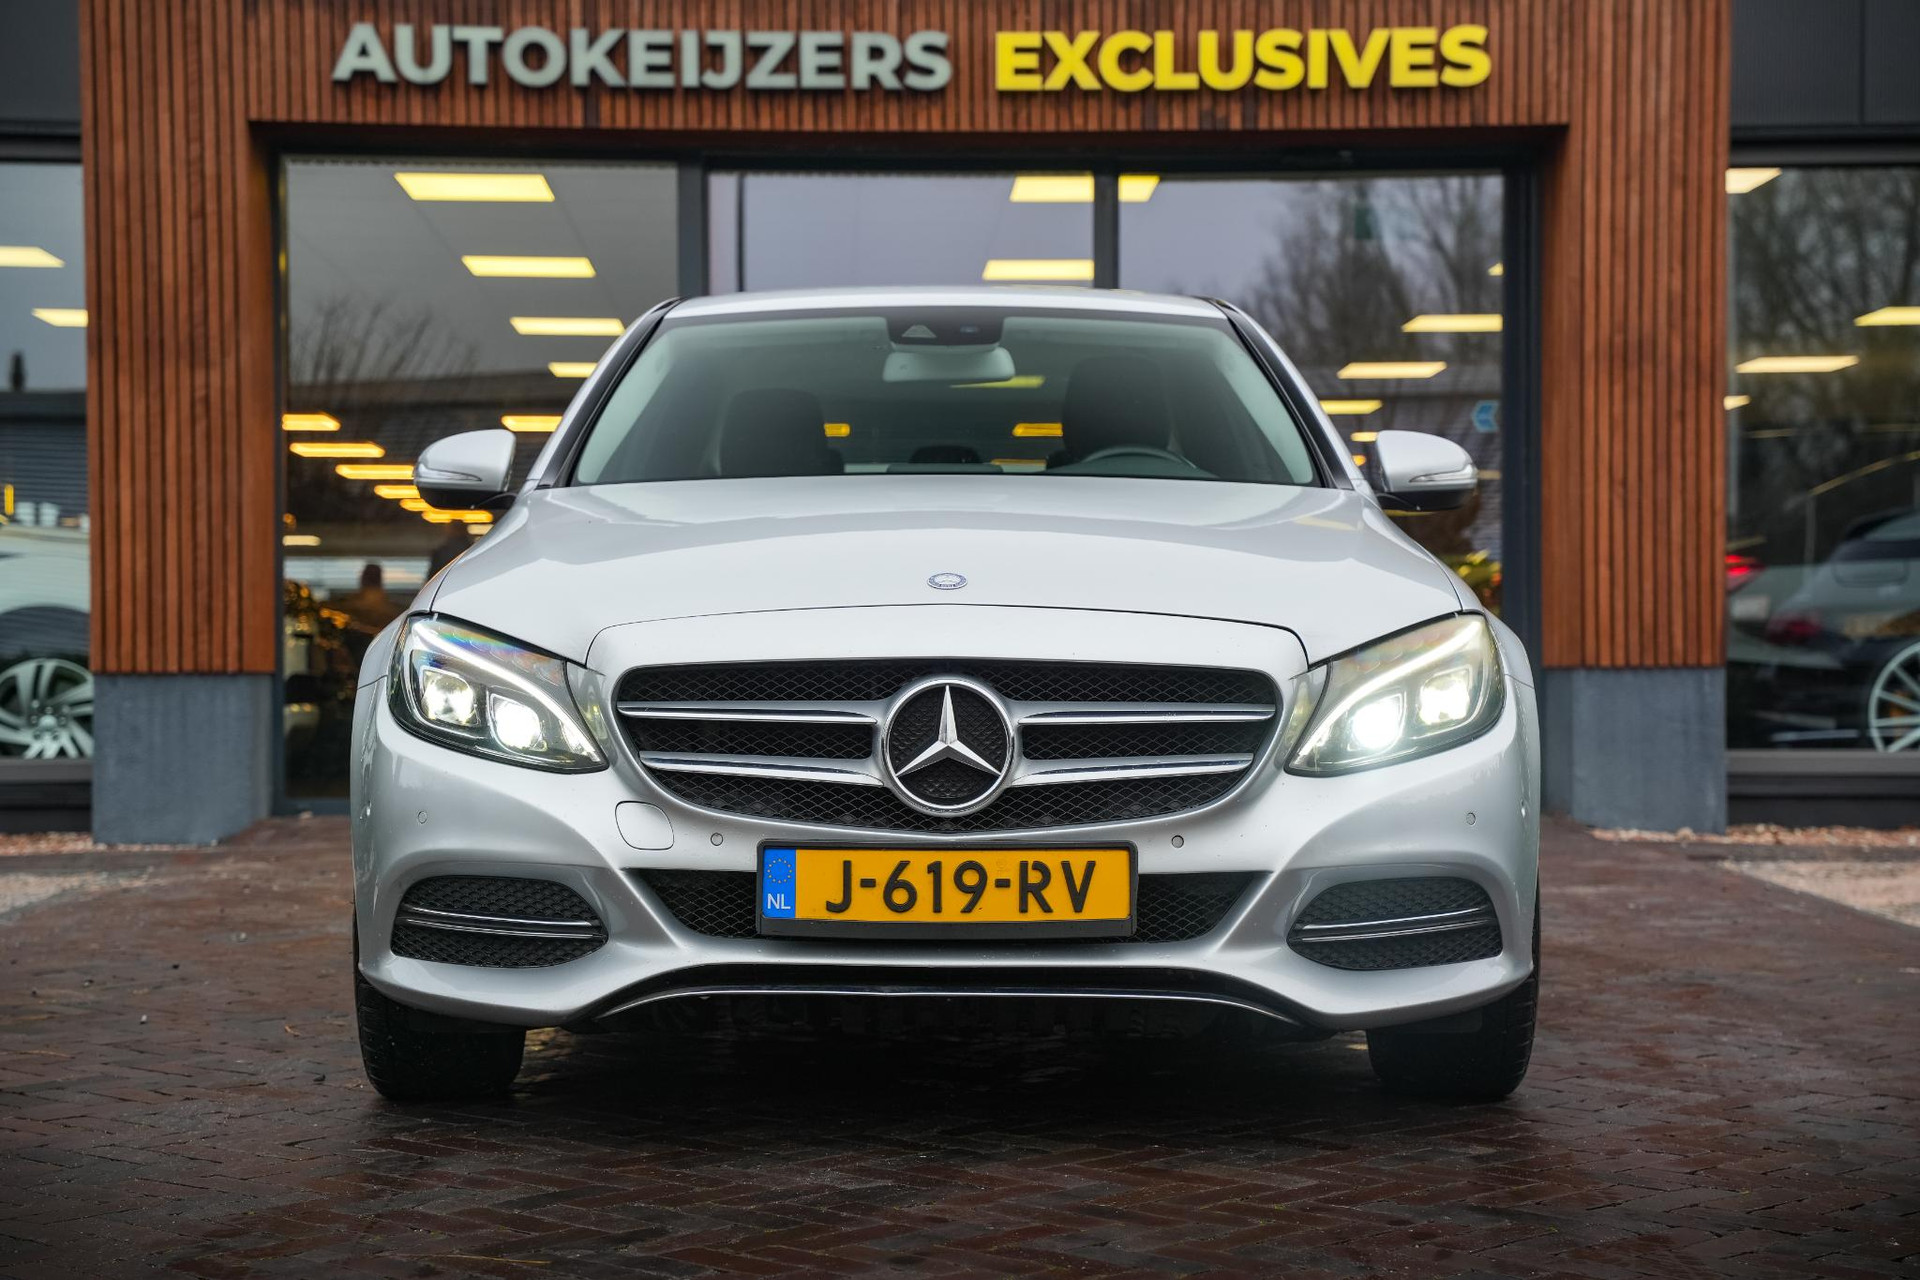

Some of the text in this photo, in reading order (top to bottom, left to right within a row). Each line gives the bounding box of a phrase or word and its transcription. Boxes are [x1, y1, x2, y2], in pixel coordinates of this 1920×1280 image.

[331, 22, 1492, 92] AUTOKEIJZERS EXCLUSIVES
[766, 893, 791, 910] NL
[825, 860, 1096, 914] J-619-RV
